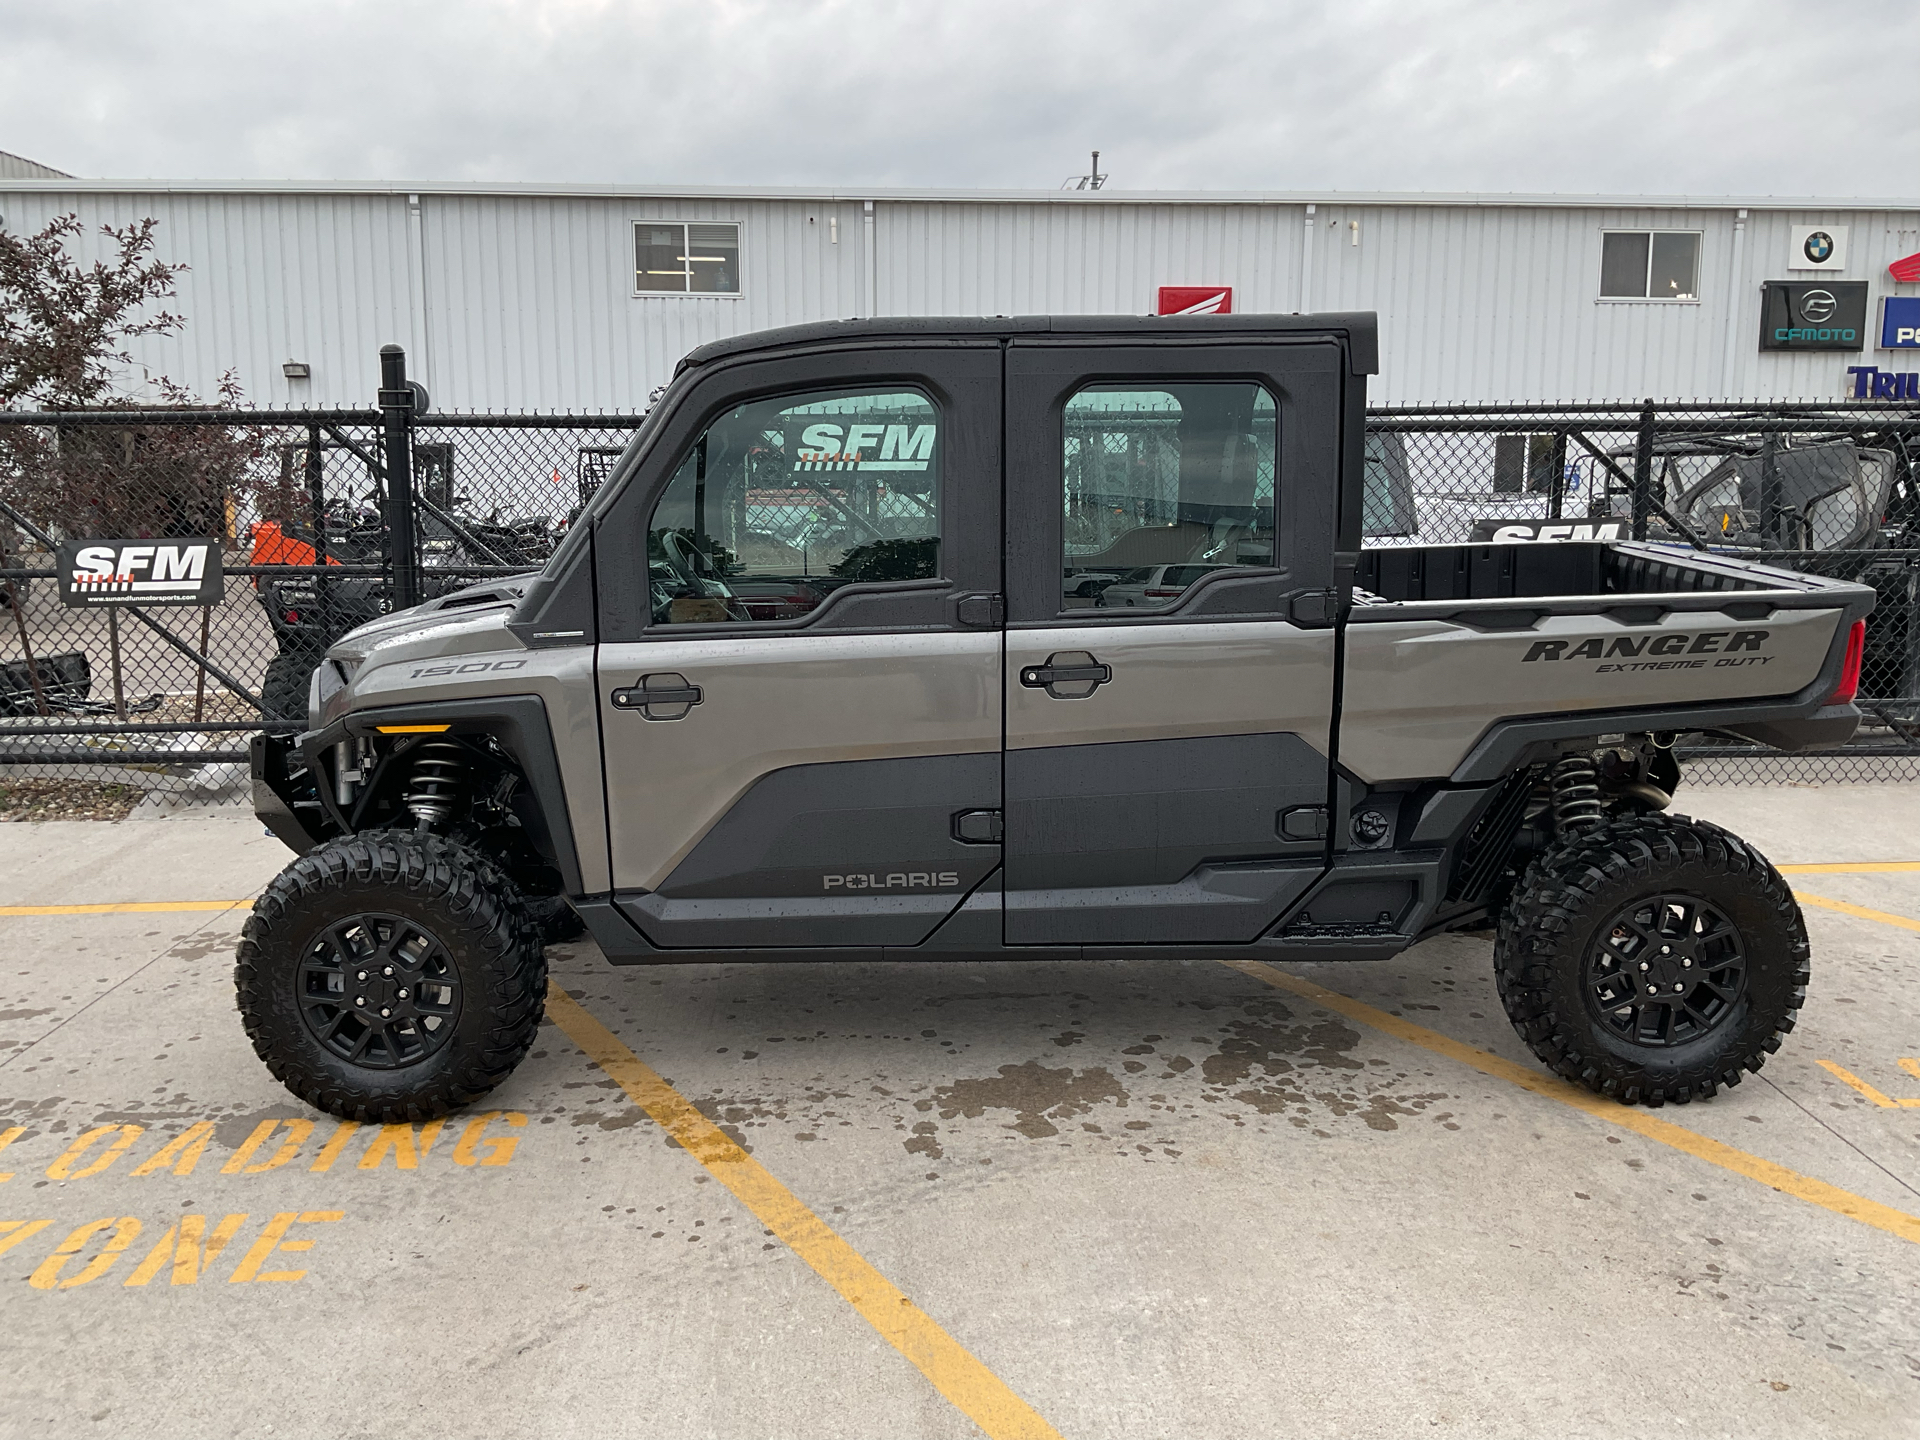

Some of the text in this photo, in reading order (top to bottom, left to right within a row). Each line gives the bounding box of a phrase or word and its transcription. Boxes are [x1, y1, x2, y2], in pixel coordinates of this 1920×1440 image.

[1774, 328, 1856, 341] CFMOTO
[1896, 327, 1920, 344] P
[797, 423, 936, 462] SFM
[72, 545, 208, 583] SFM
[87, 594, 197, 603] www.sunandfunmotorsports.com
[1521, 630, 1770, 662] RANGER
[409, 659, 528, 679] 1500
[1595, 656, 1775, 673] EXTREME DUTY
[823, 871, 960, 890] POLARIS
